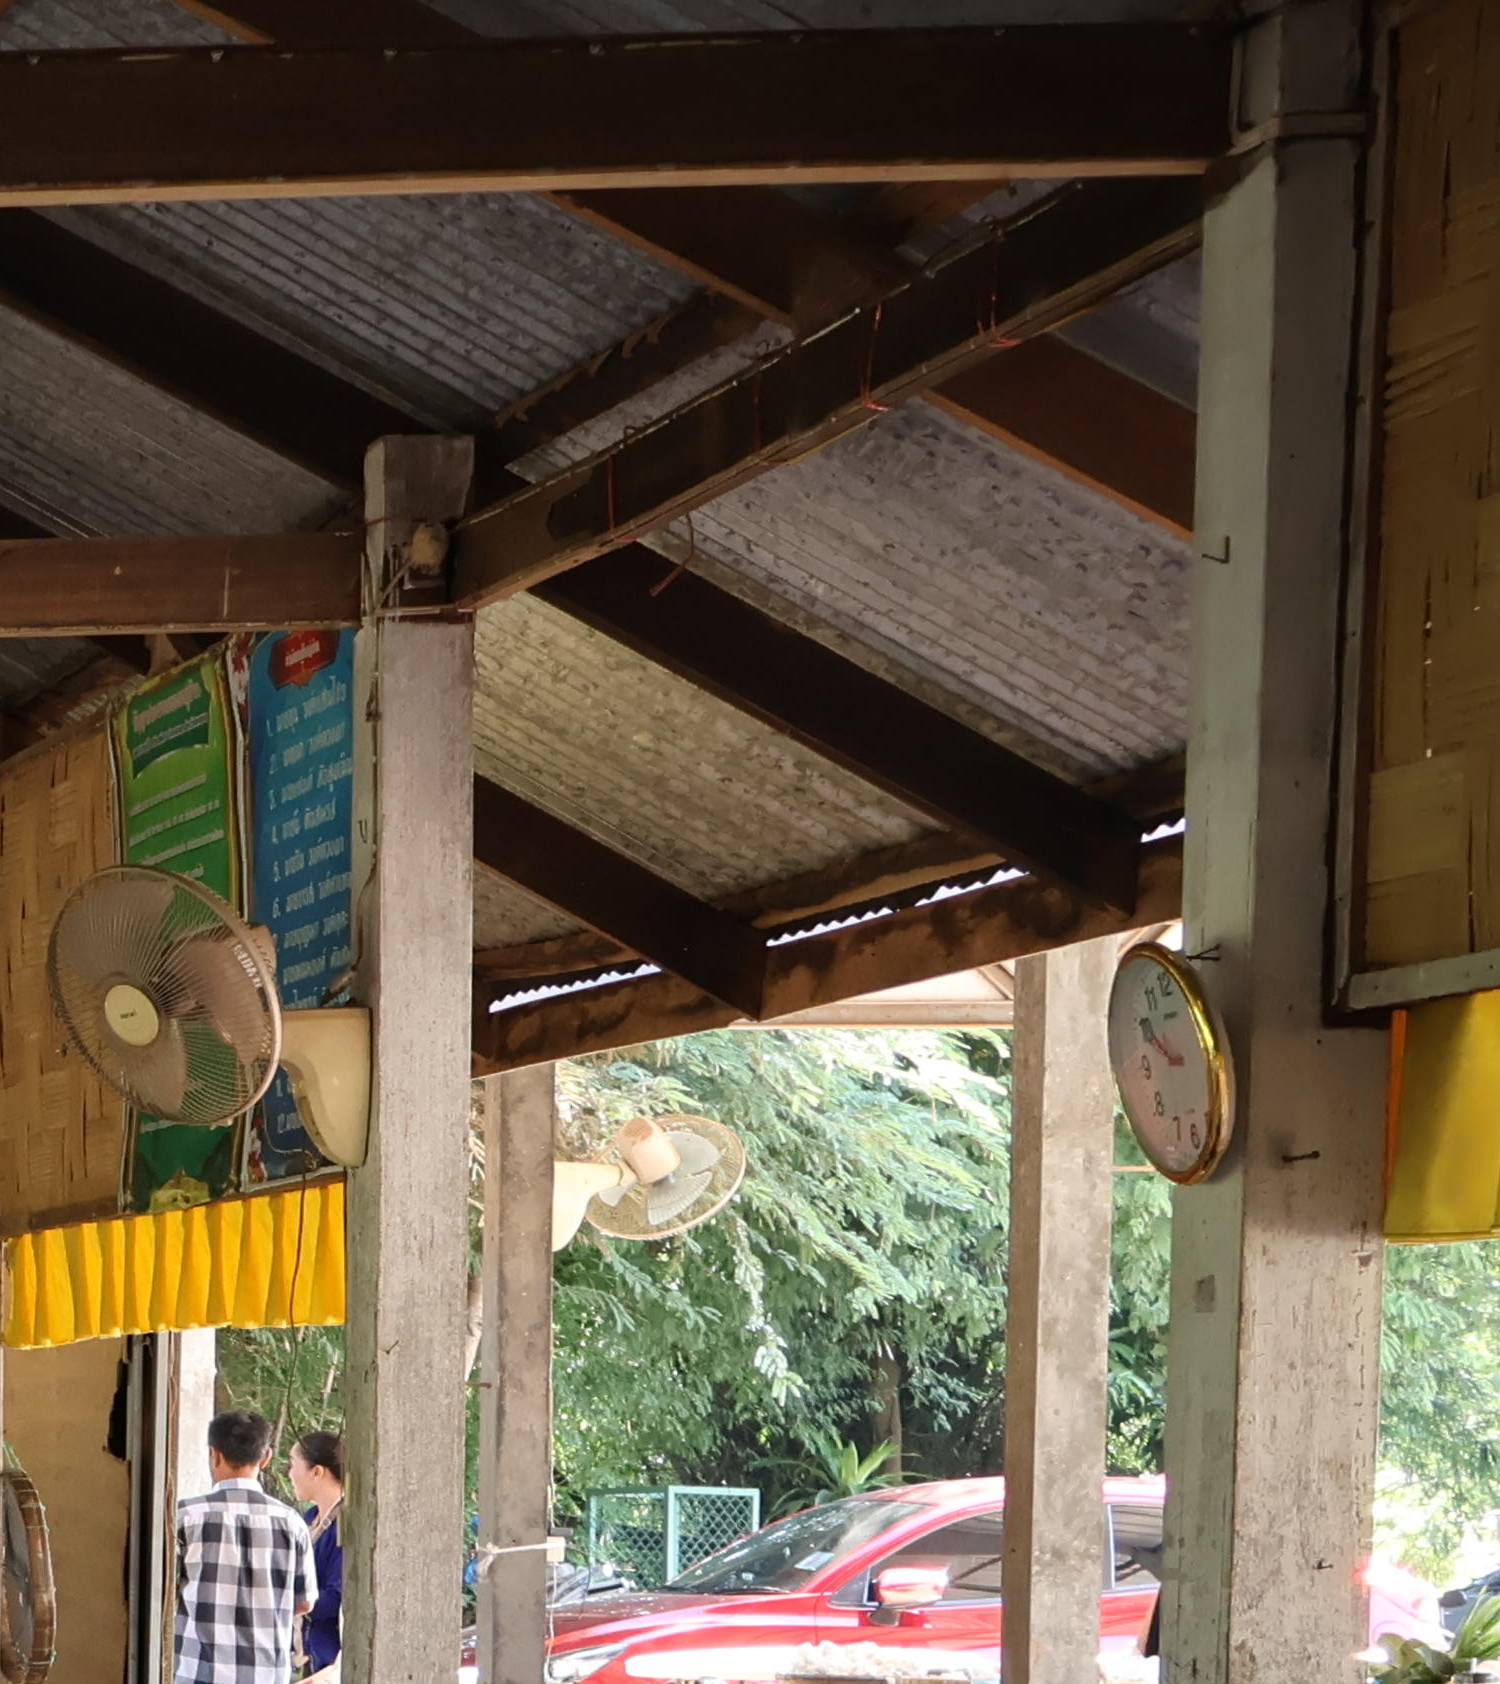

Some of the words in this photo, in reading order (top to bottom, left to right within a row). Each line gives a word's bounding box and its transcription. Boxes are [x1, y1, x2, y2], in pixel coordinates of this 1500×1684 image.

[1157, 971, 1174, 998] 12
[1144, 986, 1158, 1012] 11
[1140, 1054, 1152, 1081] 9
[1172, 1115, 1183, 1142] 7
[1189, 1122, 1200, 1150] 6
